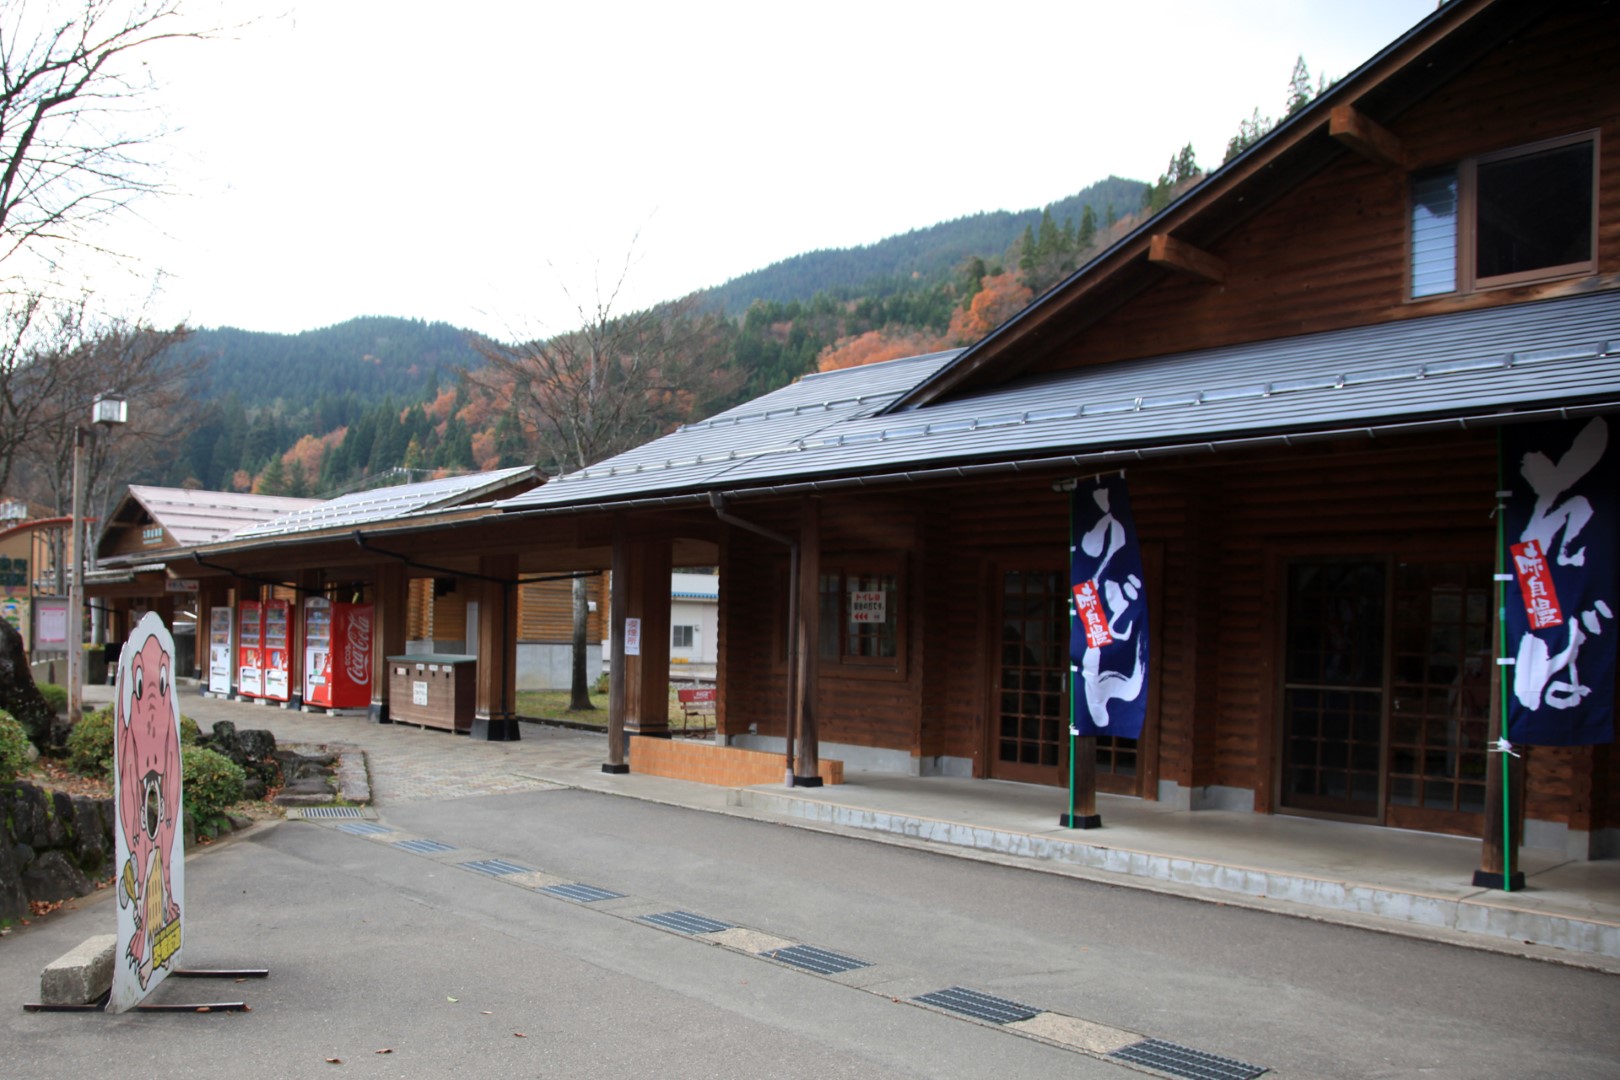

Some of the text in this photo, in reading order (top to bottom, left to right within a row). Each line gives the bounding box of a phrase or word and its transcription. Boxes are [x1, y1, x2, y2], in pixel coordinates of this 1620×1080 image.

[1075, 582, 1112, 647] 味自慢
[1081, 487, 1145, 727] うどん
[1513, 416, 1614, 711] そば
[1515, 541, 1562, 628] 味自慢
